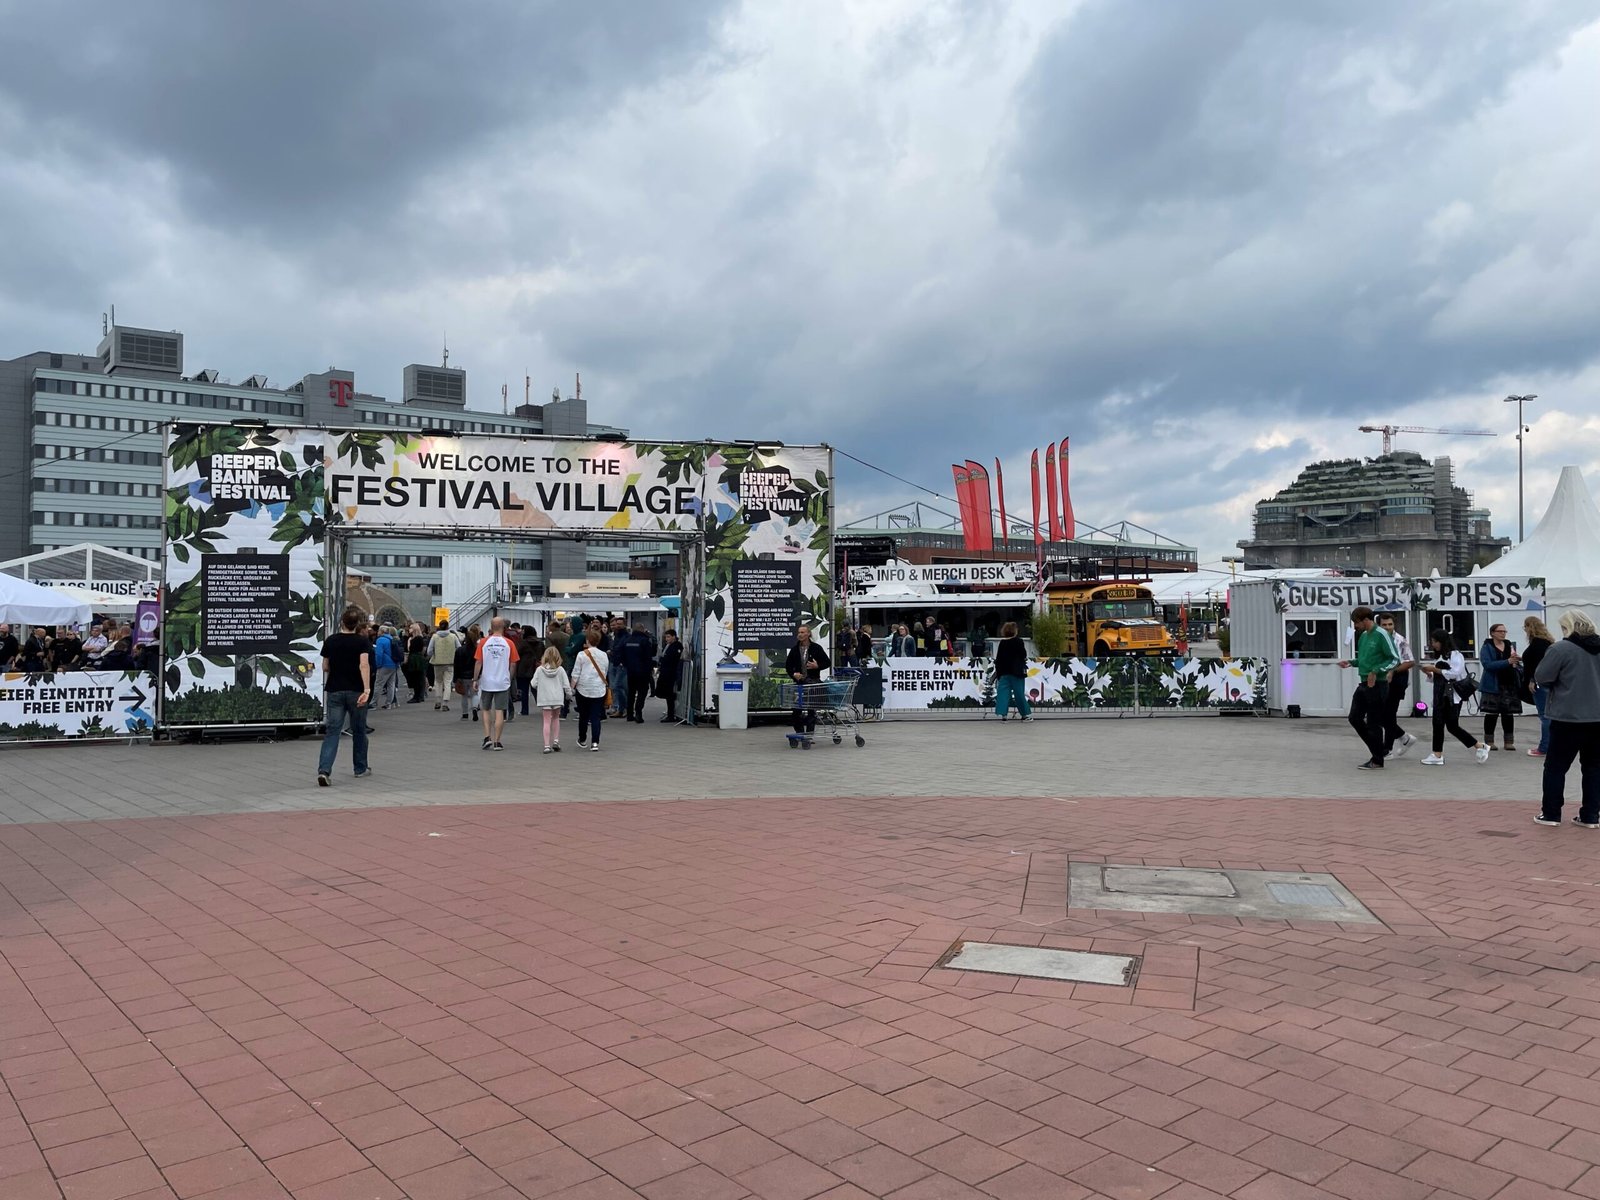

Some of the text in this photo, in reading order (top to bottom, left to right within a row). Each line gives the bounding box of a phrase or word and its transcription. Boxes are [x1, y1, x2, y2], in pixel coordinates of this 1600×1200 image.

[212, 454, 276, 470] REEPER
[418, 452, 620, 476] WELCOME TO THE
[211, 468, 259, 484] BAHN
[740, 472, 790, 486] REEPER
[211, 484, 290, 500] FESTIVAL
[331, 474, 696, 515] FESTIVAL VILLAGE
[740, 485, 778, 498] BAHN
[740, 498, 804, 511] FESTIVAL
[877, 567, 1005, 581] INFO & MERCH DESK
[91, 582, 136, 595] HOUSE
[1288, 584, 1402, 607] GUESTLIST
[1440, 582, 1522, 606] PRESS
[892, 670, 984, 679] FREIER EINTRITT
[892, 681, 954, 691] FREE ENTRY
[40, 687, 114, 700] EINTRITT
[23, 700, 114, 714] FREE ENTRY
